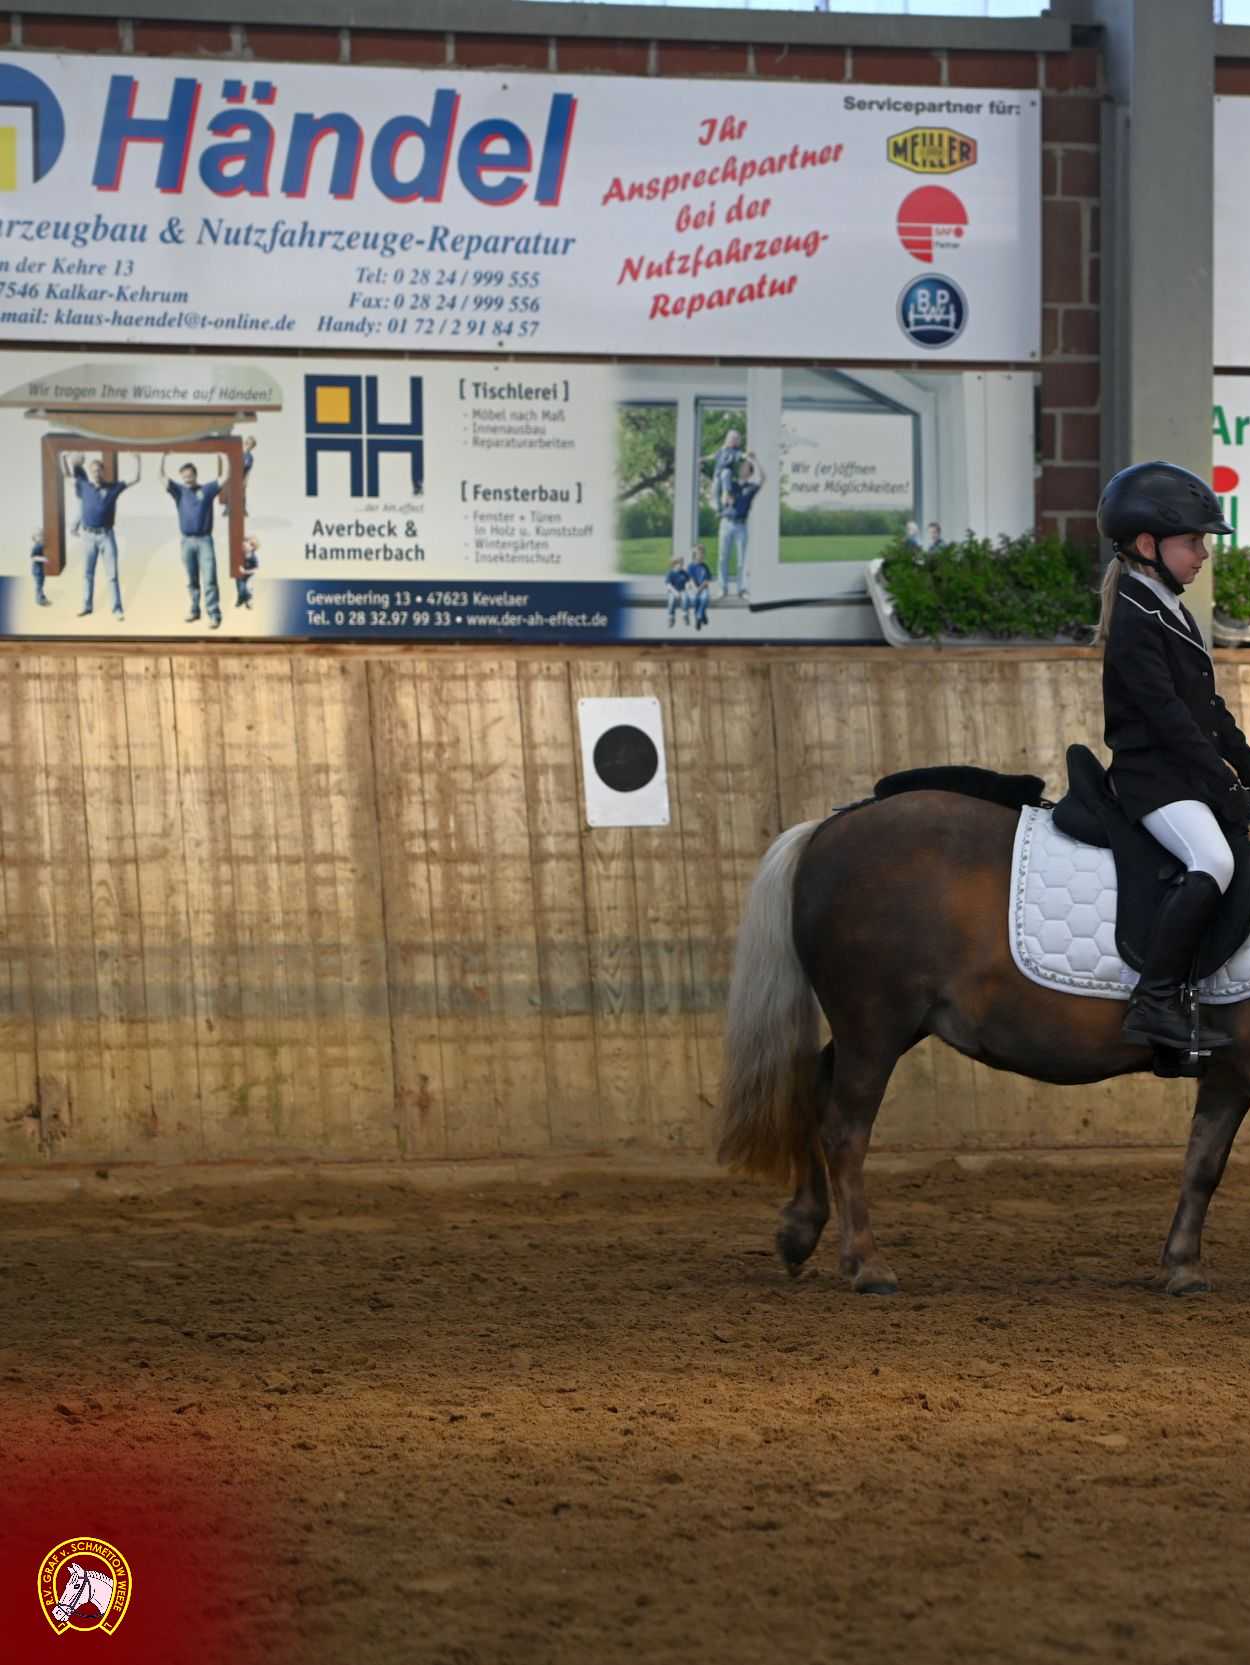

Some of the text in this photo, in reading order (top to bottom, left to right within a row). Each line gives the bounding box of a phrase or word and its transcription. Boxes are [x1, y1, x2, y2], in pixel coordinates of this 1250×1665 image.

[843, 96, 1021, 115] Servicepartner für:
[698, 115, 748, 146] Ihr
[91, 74, 578, 207] Händel
[602, 143, 843, 206] Ansprechpartner
[674, 197, 772, 234] bei der
[0, 214, 576, 260] rzeugbau & Nutzfahrzeuge-Reparatur
[16, 256, 46, 273] der
[53, 258, 106, 276] Kehre
[114, 260, 134, 276] 13
[617, 230, 829, 286] Nutzfahrzeug-
[356, 267, 540, 288] Tel: 0 28 24 999 555
[45, 283, 188, 304] Kalkar-Kehrum
[348, 292, 540, 313] Fax: 0 28 24 999 556
[649, 275, 798, 320] Reparatur
[54, 310, 296, 332] klaus-haendel@t-online.de
[316, 315, 540, 337] Handy: 01 72 2 91 84 57
[28, 383, 49, 396] Wir
[54, 385, 97, 400] tragen
[101, 384, 128, 397] Ihre
[133, 385, 188, 400] Wünsche
[192, 386, 216, 402] auf
[472, 382, 557, 400] Tischlerei
[473, 409, 565, 422] Möbel nach Maß
[473, 423, 546, 435] Innenausbau
[472, 437, 575, 449] Reparaturarbeiten
[473, 484, 570, 501] Fensterbau
[473, 511, 561, 522] Fenster Türen
[312, 520, 418, 537] Averbeck &
[491, 526, 515, 536] Holz
[536, 524, 593, 536] Kunststoff
[305, 543, 425, 561] Hammerbach
[475, 539, 549, 551] Wintergärten
[475, 552, 561, 564] Insektenschutz
[306, 590, 528, 609] Gewerbering 13 47623 Kevelaer
[306, 610, 608, 627] Tel. 0 28 32.97 99 33 www.der-ah-effect.de
